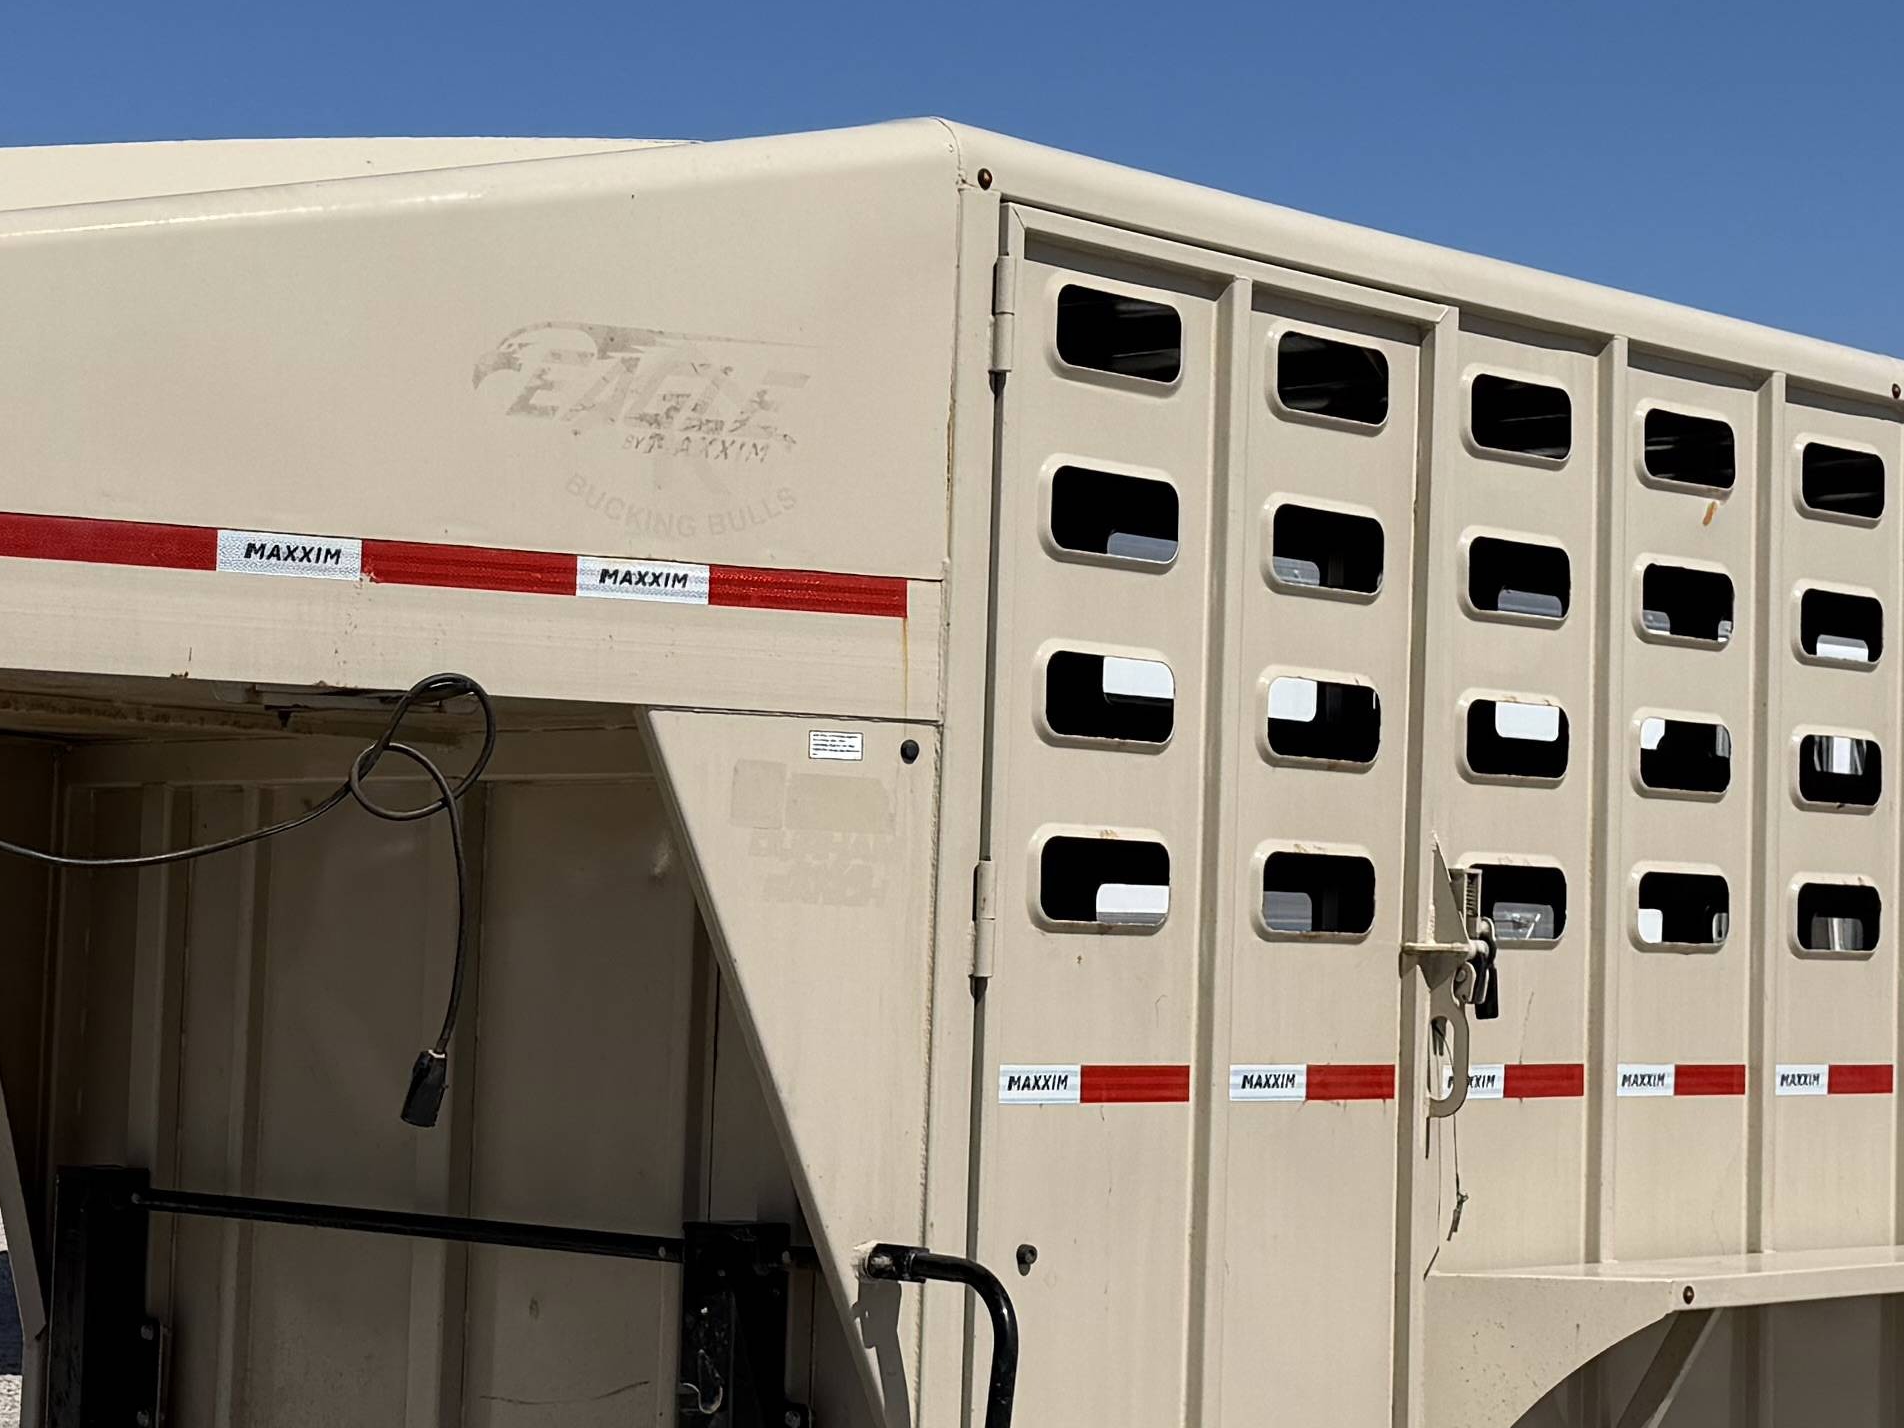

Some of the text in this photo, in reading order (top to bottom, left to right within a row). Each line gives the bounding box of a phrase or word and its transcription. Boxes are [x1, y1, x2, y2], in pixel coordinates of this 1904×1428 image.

[244, 541, 342, 566] MAXXIM
[598, 567, 688, 589] MAXXIM
[1007, 1074, 1068, 1091] MAXXIM
[1241, 1073, 1296, 1089] MAXXIM
[1621, 1073, 1665, 1087] MAXXIM
[1780, 1073, 1820, 1087] MAXXIM
